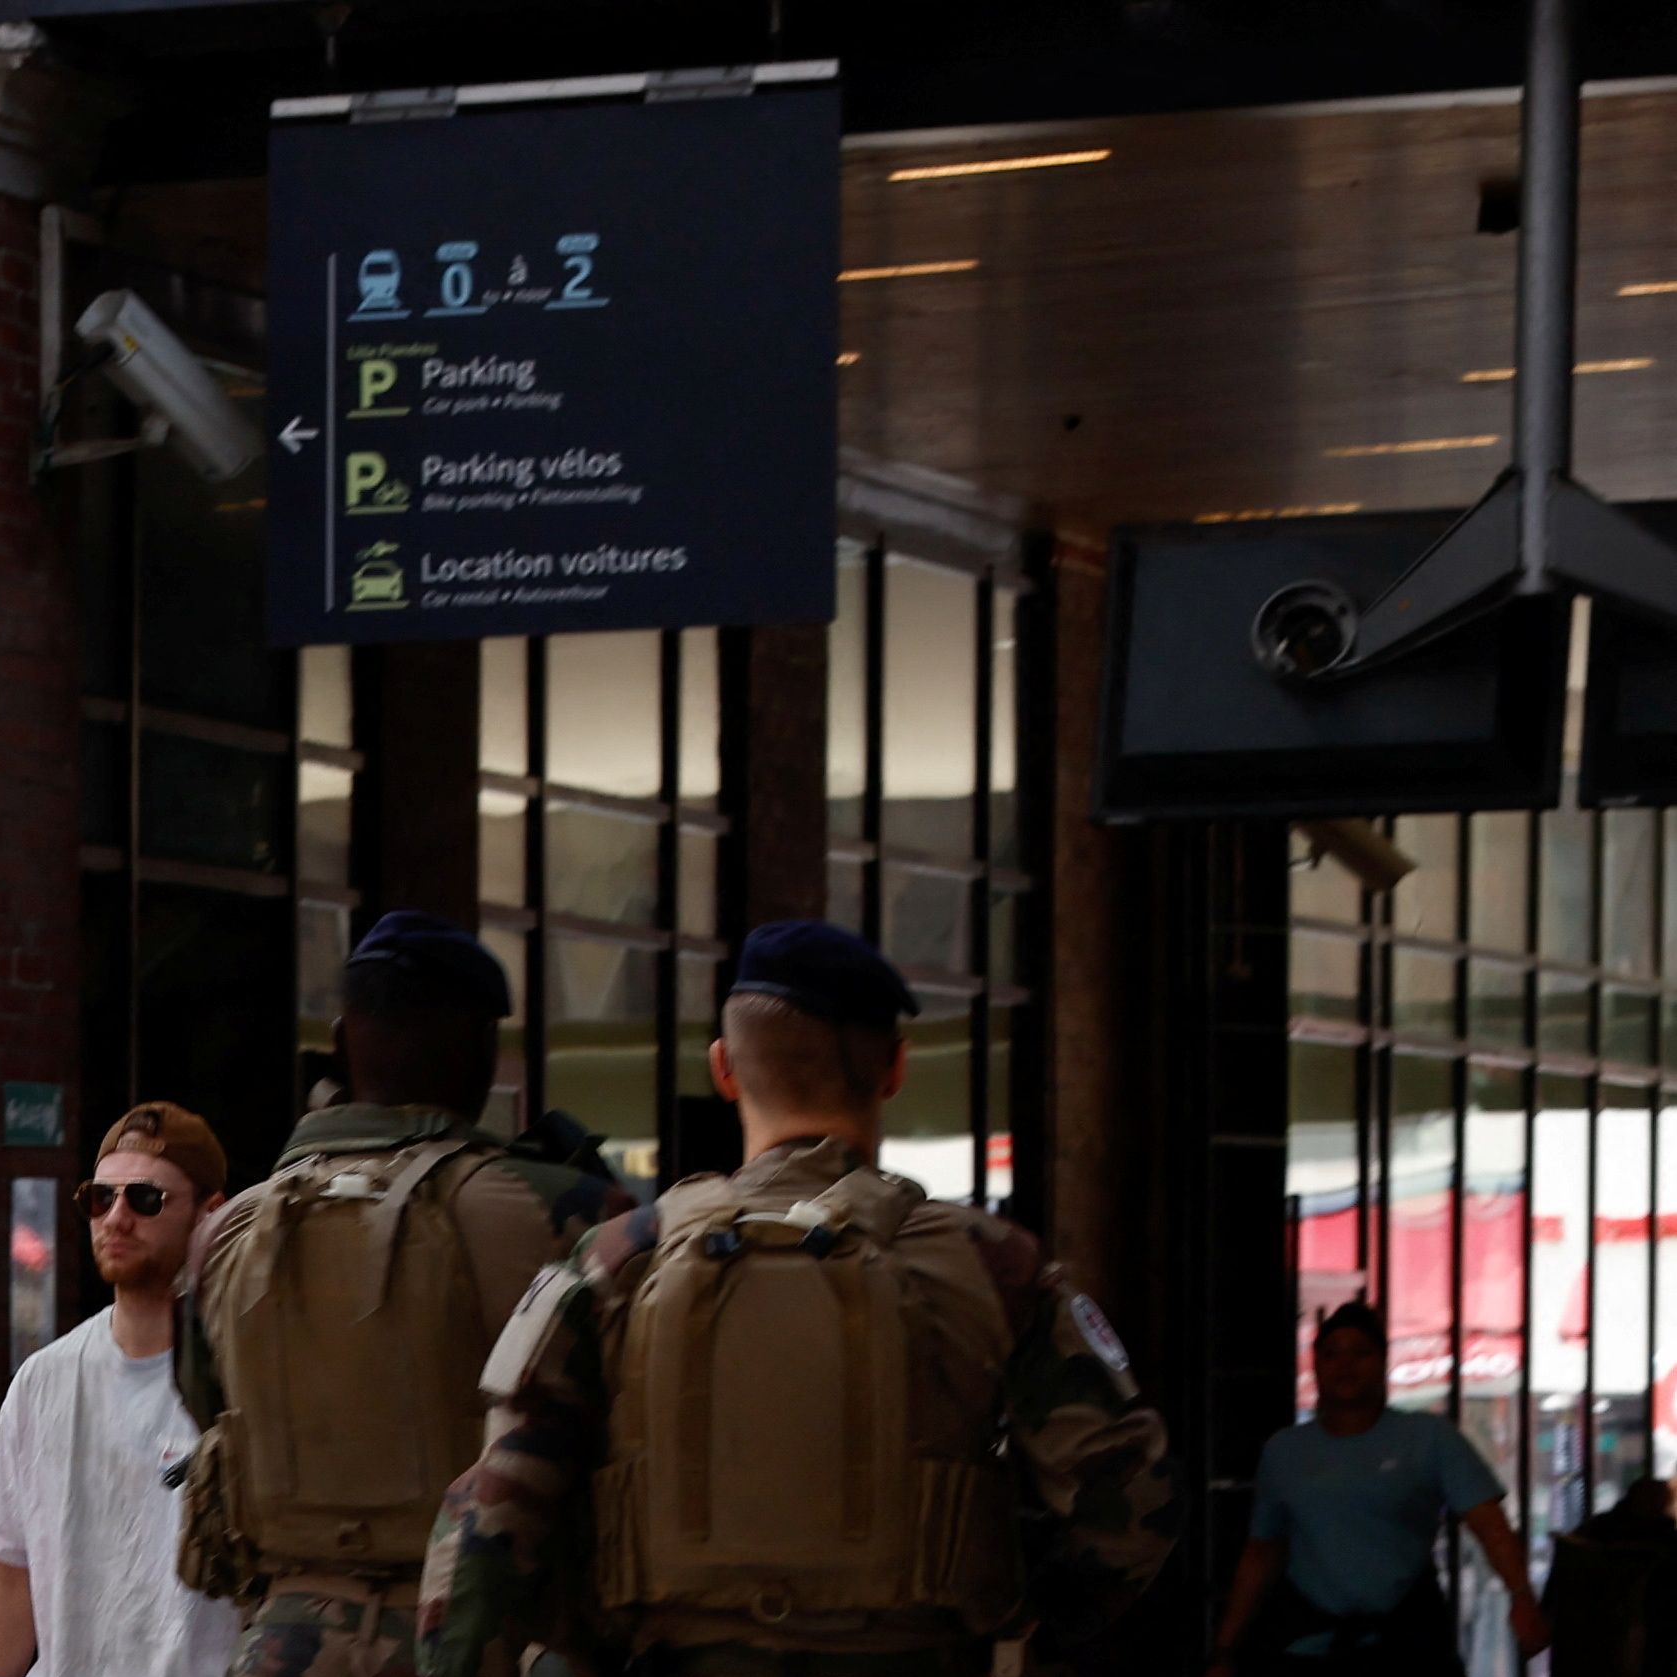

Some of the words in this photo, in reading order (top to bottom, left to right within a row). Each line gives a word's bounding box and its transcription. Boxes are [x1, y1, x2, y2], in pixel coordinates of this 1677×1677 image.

[561, 254, 593, 300] 2
[421, 354, 536, 392] Parking
[421, 451, 535, 489] Parking
[539, 446, 623, 480] vélos
[421, 547, 554, 584] Location
[559, 543, 688, 576] voitures
